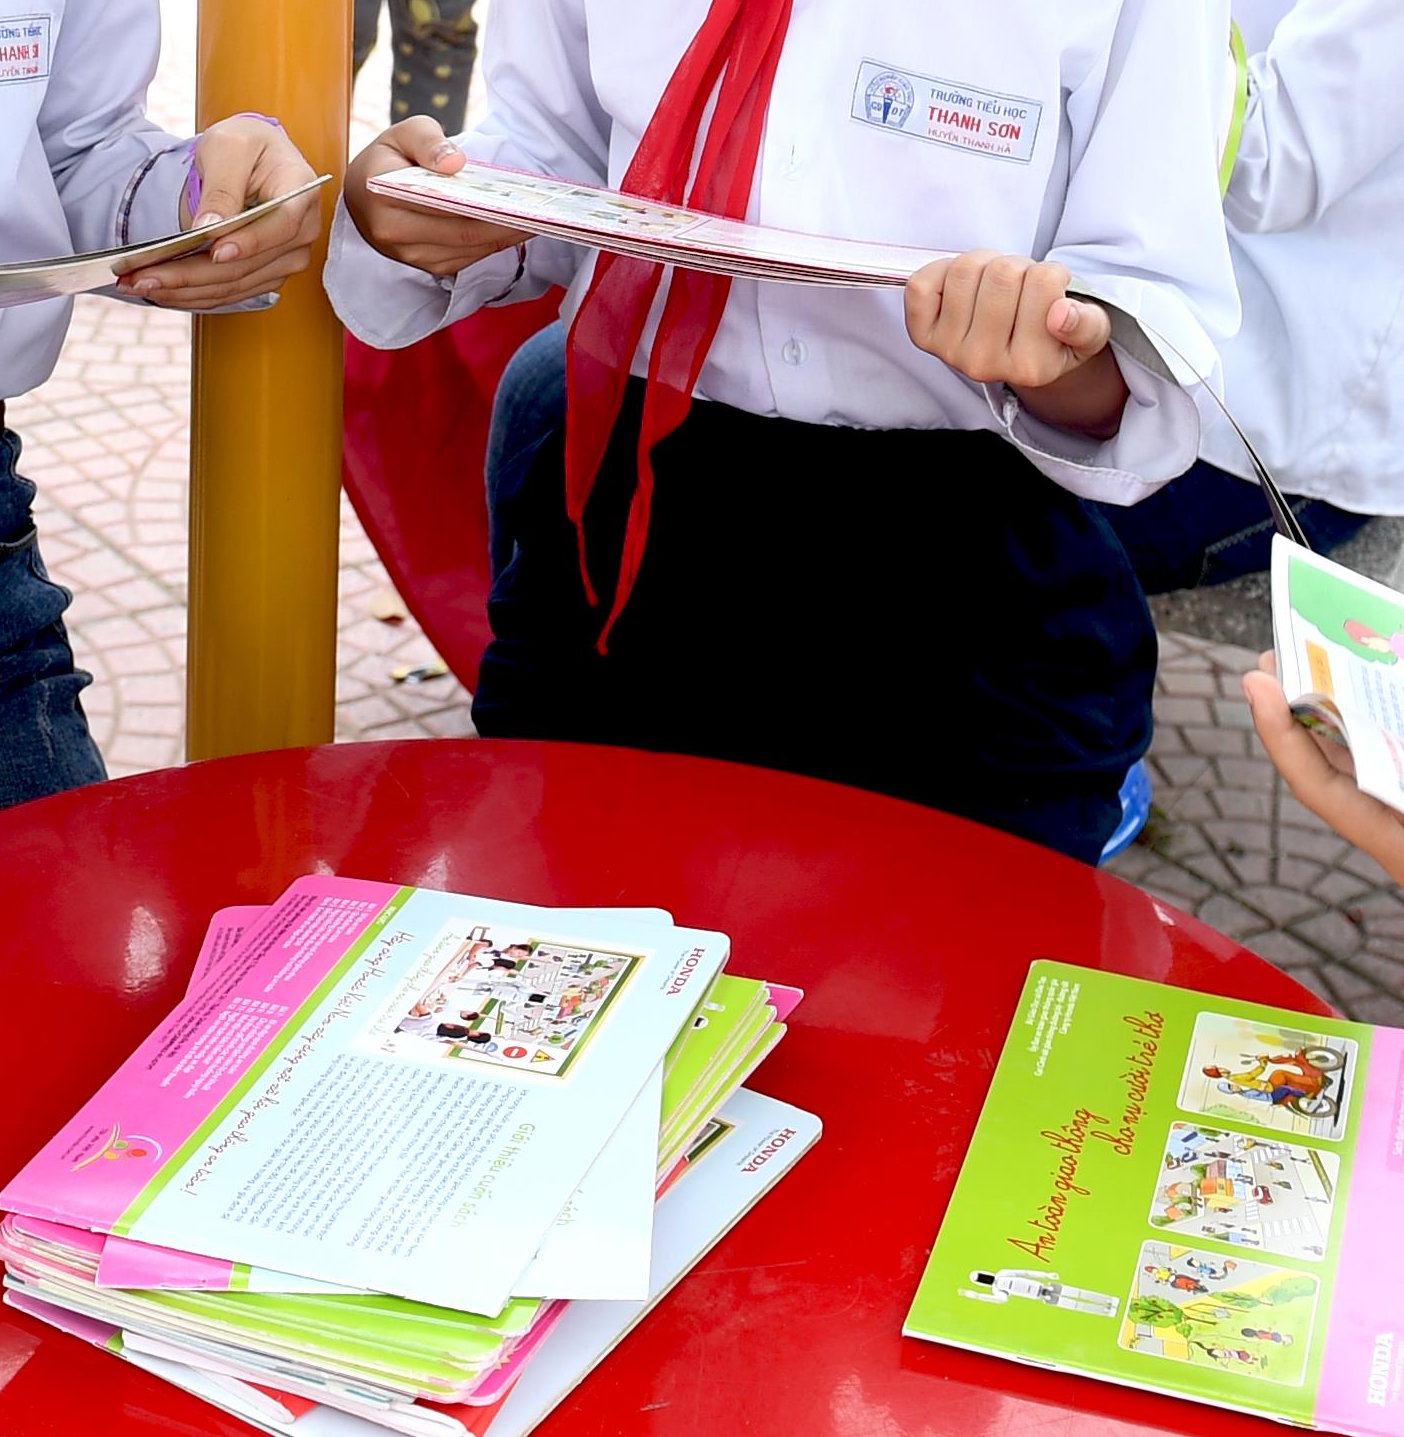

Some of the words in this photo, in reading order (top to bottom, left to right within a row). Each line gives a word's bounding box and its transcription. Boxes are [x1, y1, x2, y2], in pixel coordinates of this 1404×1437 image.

[930, 88, 973, 108] TRƯỜNG
[976, 99, 1001, 115] TIỂU
[1003, 106, 1027, 121] HỌC
[928, 105, 981, 132] THANH
[987, 121, 1021, 141] SƠN
[666, 947, 705, 995] HONDA
[1122, 1010, 1164, 1039] thơ
[1125, 1039, 1158, 1067] trẻ
[1119, 1066, 1151, 1102] cười
[1040, 1107, 1109, 1154] thông
[1121, 1102, 1147, 1125] nụ
[508, 1122, 536, 1144] Giới
[741, 1127, 797, 1173] HONDA
[1089, 1119, 1135, 1155] cho
[486, 1145, 521, 1173] thiệu
[1054, 1154, 1090, 1196] giao
[467, 1173, 496, 1200] cuốn
[450, 1201, 477, 1227] sách
[1027, 1191, 1067, 1232] toàn
[1006, 1231, 1056, 1263] An
[1365, 1328, 1395, 1407] HONDA
